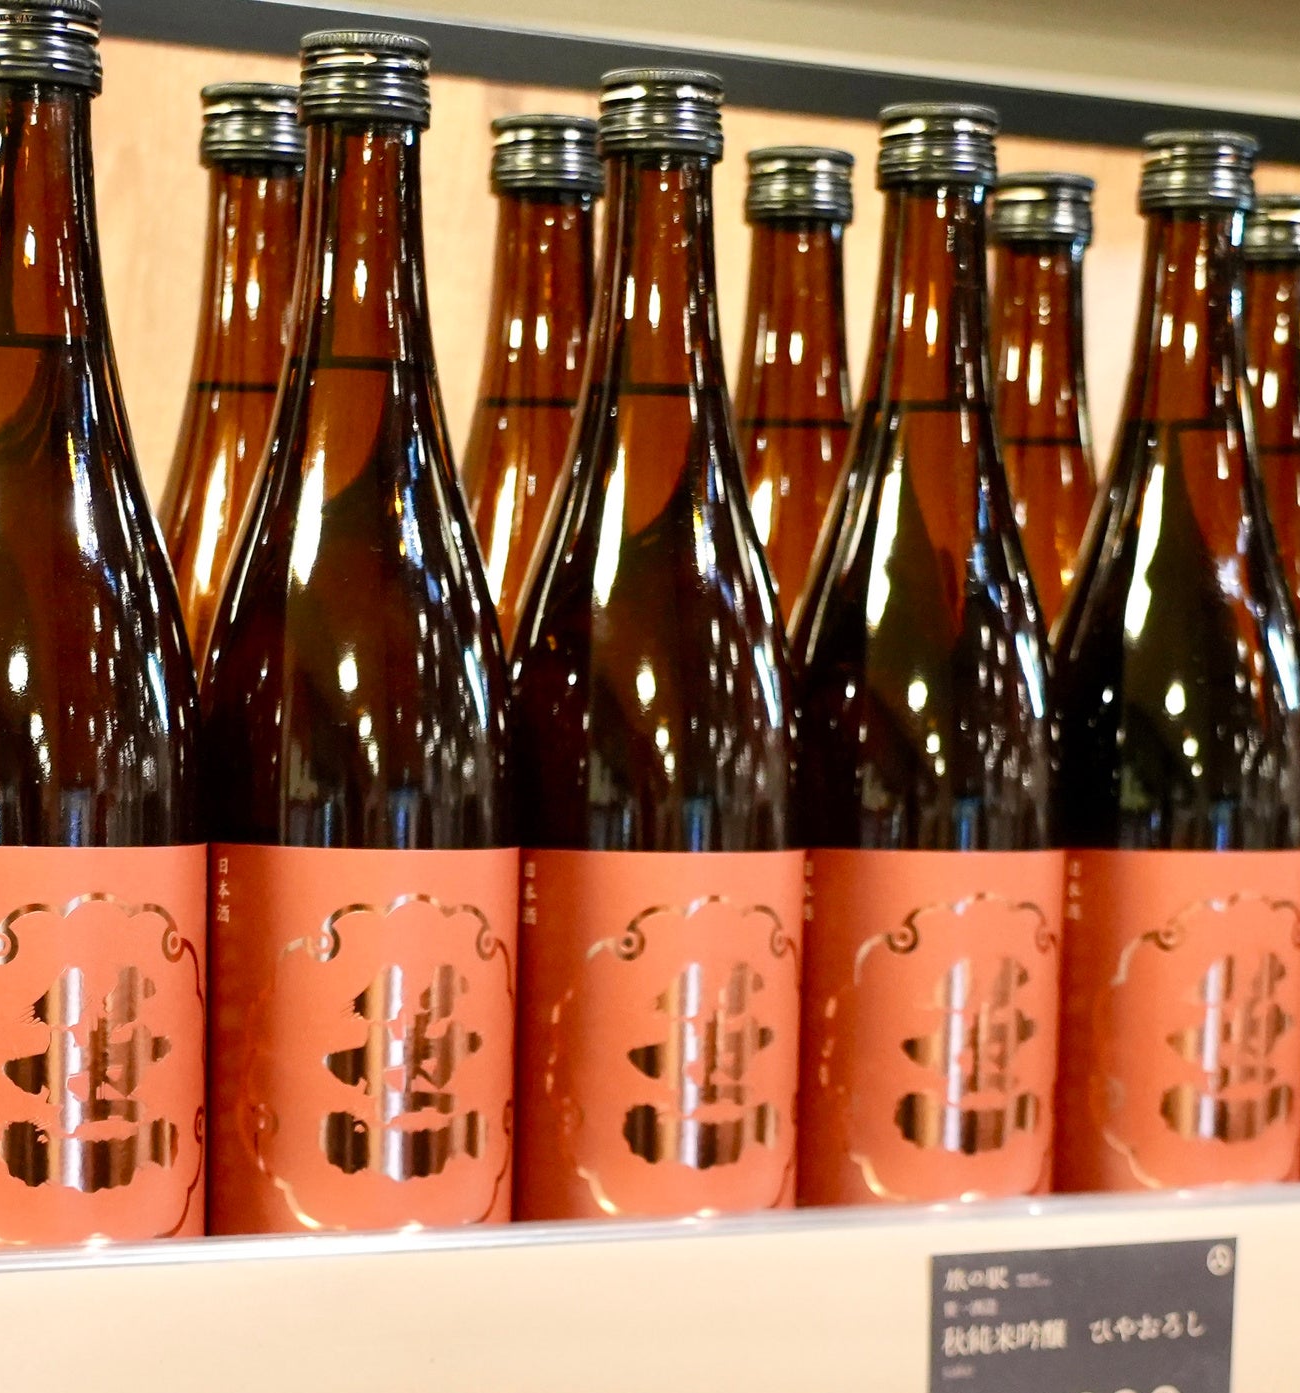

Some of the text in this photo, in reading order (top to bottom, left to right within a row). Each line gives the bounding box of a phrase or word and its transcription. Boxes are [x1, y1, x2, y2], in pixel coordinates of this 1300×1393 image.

[1088, 1310, 1208, 1344] ひやおろし
